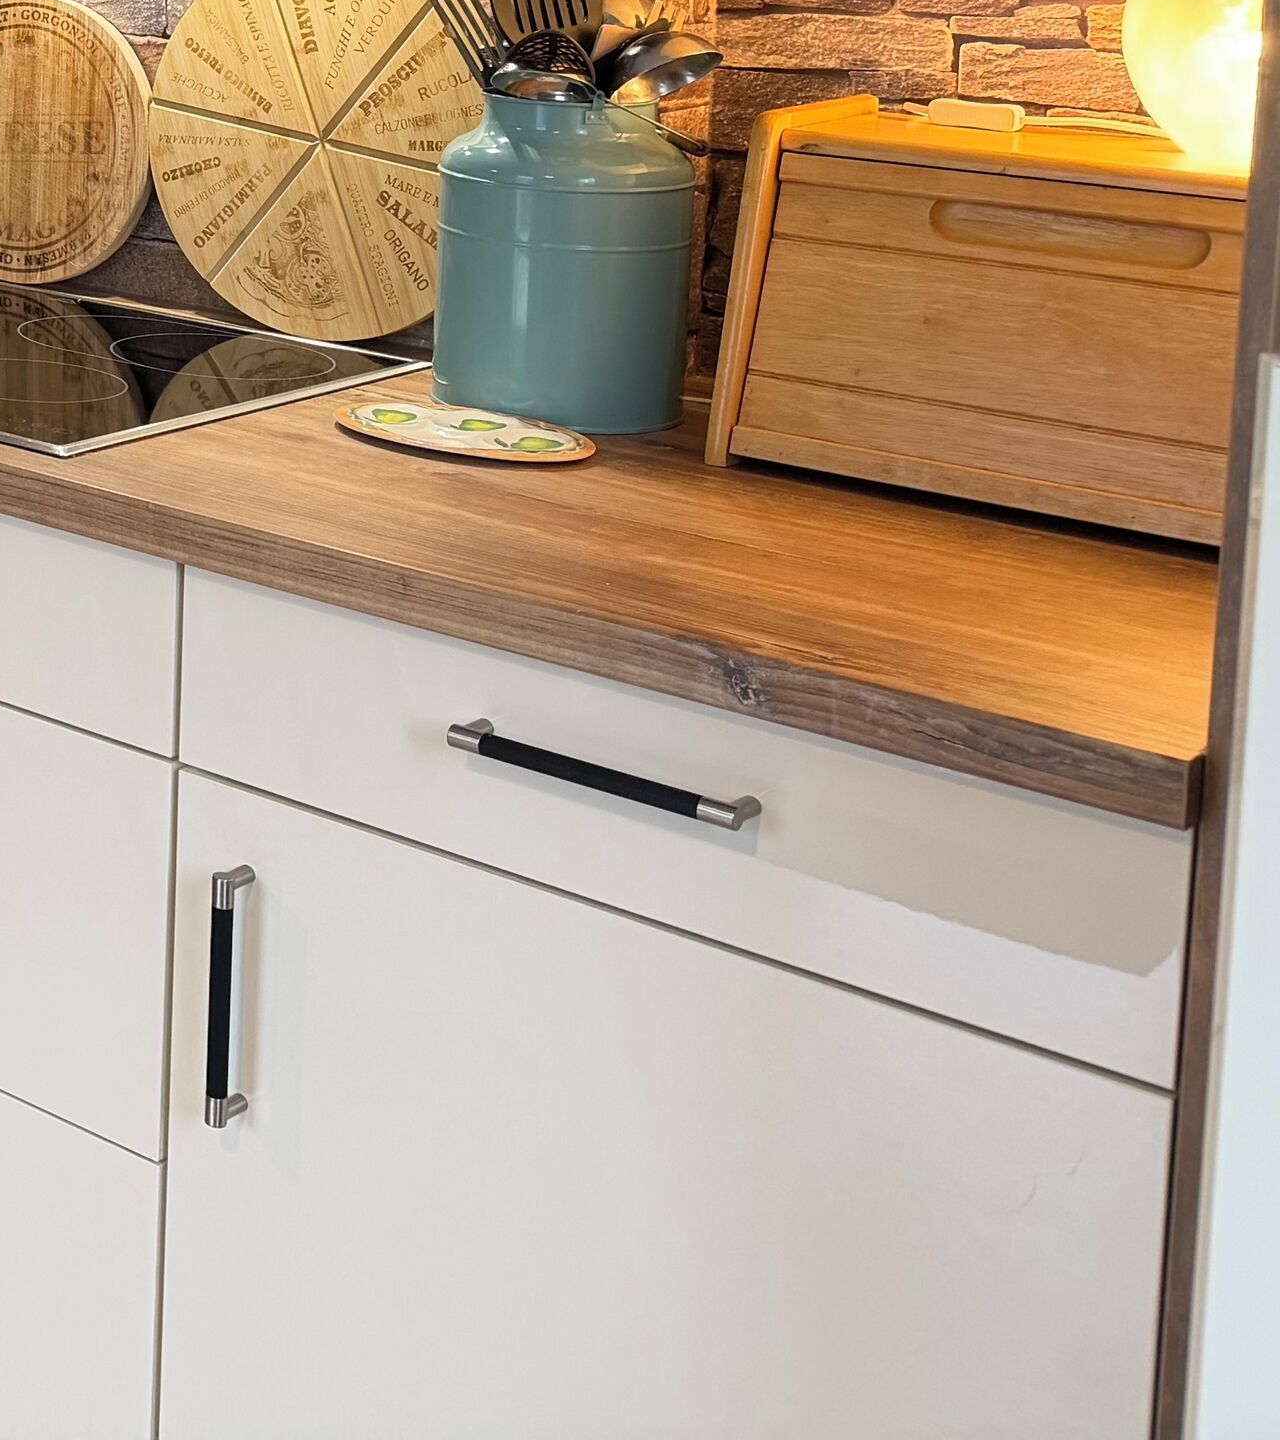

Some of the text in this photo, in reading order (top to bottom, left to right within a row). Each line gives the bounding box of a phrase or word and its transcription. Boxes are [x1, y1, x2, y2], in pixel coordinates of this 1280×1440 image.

[185, 37, 273, 114] BASILICO FRESCO
[324, 27, 351, 91] FUNGHI
[345, 14, 357, 28] E
[171, 71, 230, 103] ACCIUGHE
[159, 134, 215, 145] MARINARA
[422, 103, 485, 127] BOLOGNES
[162, 156, 221, 182] CHORIZO
[173, 170, 242, 218] BRACCIO DI FERRO
[384, 174, 420, 199] MARE
[422, 193, 431, 203] E
[193, 162, 272, 248] PARMIGIANO
[376, 190, 438, 251] SALAM
[346, 183, 399, 308] QUATTRO STAGIONI
[383, 229, 430, 292] ORIGANO
